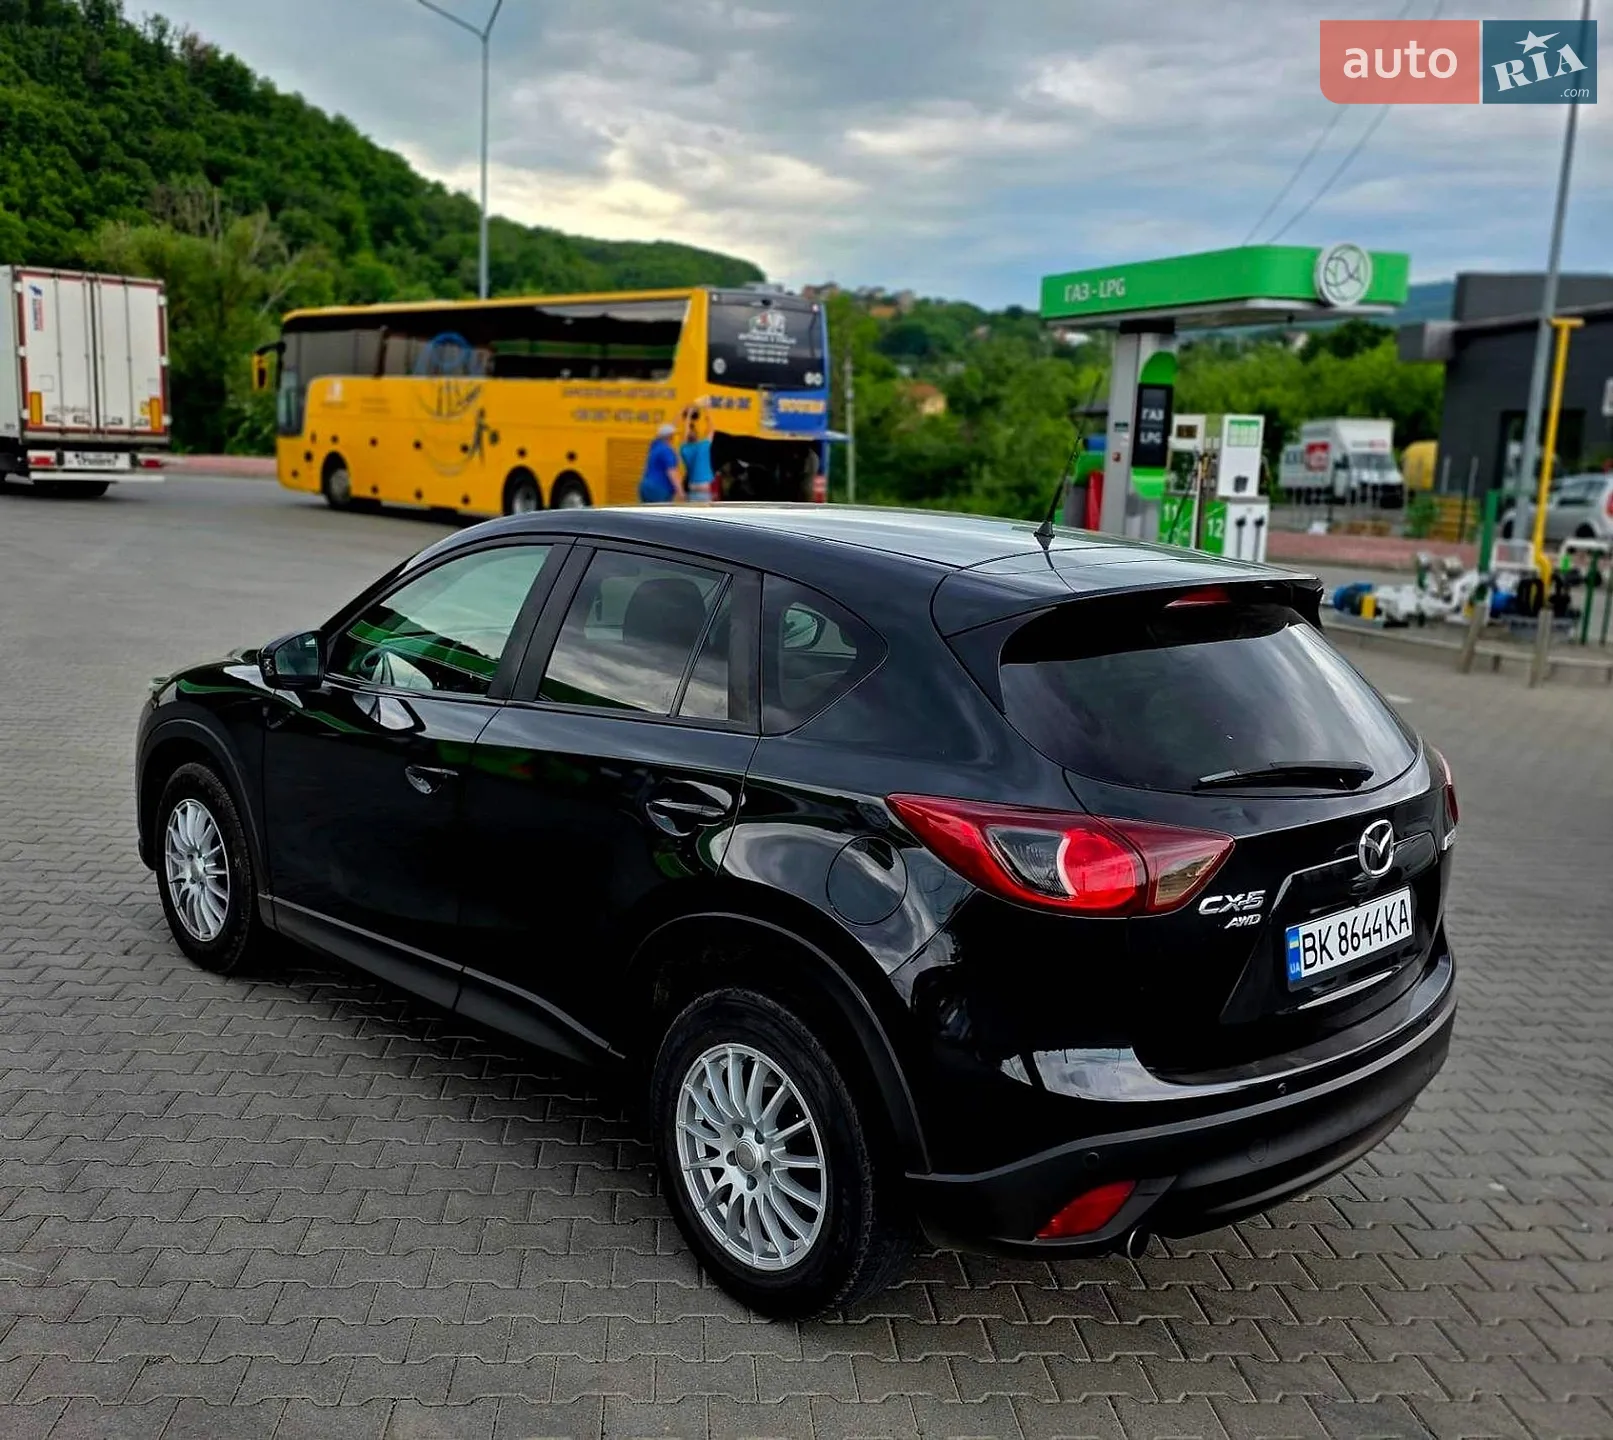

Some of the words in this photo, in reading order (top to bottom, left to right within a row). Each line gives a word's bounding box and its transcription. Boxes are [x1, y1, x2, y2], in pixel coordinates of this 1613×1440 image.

[1141, 408, 1164, 420] ГАЗ
[1140, 432, 1163, 444] LPG
[1206, 519, 1225, 537] 12
[1223, 913, 1262, 930] AWD
[1289, 963, 1301, 975] UA
